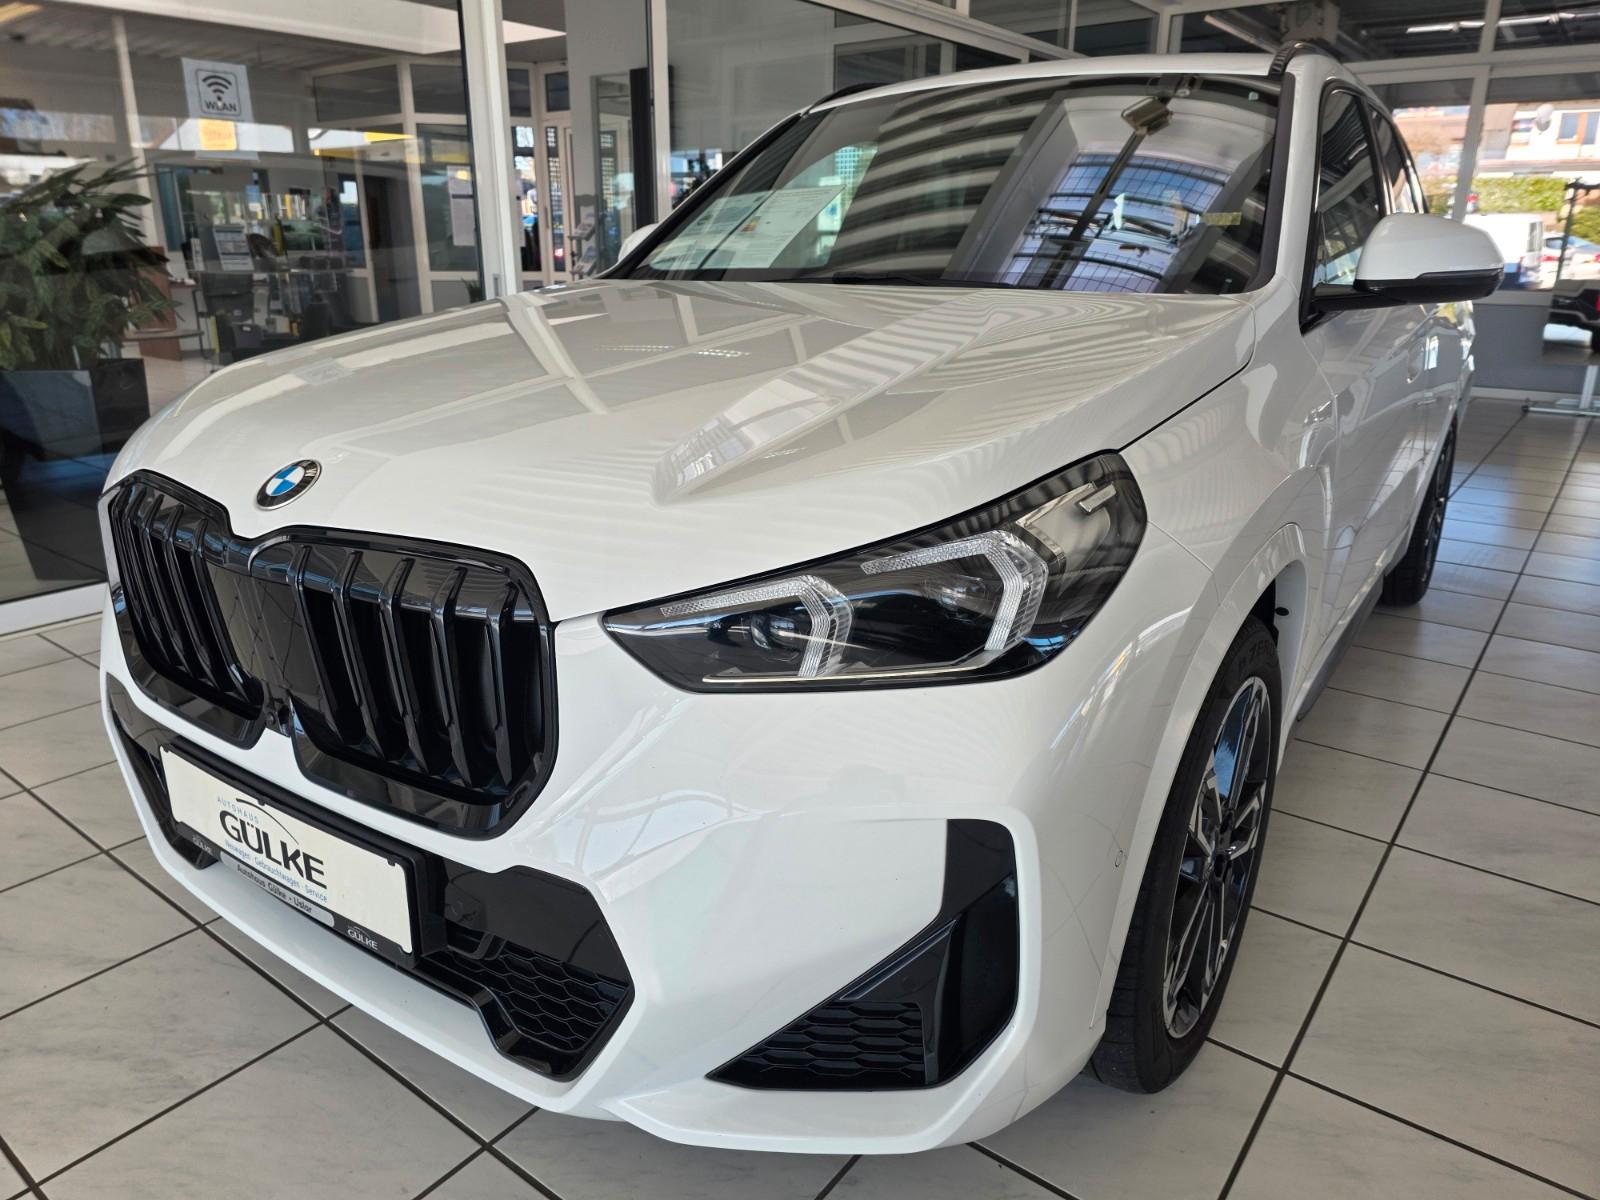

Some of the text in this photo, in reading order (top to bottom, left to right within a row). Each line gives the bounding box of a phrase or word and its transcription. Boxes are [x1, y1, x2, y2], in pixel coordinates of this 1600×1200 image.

[205, 100, 238, 113] WLAN
[217, 796, 260, 825] AUTOHAUS
[219, 810, 328, 890] GÜLKE
